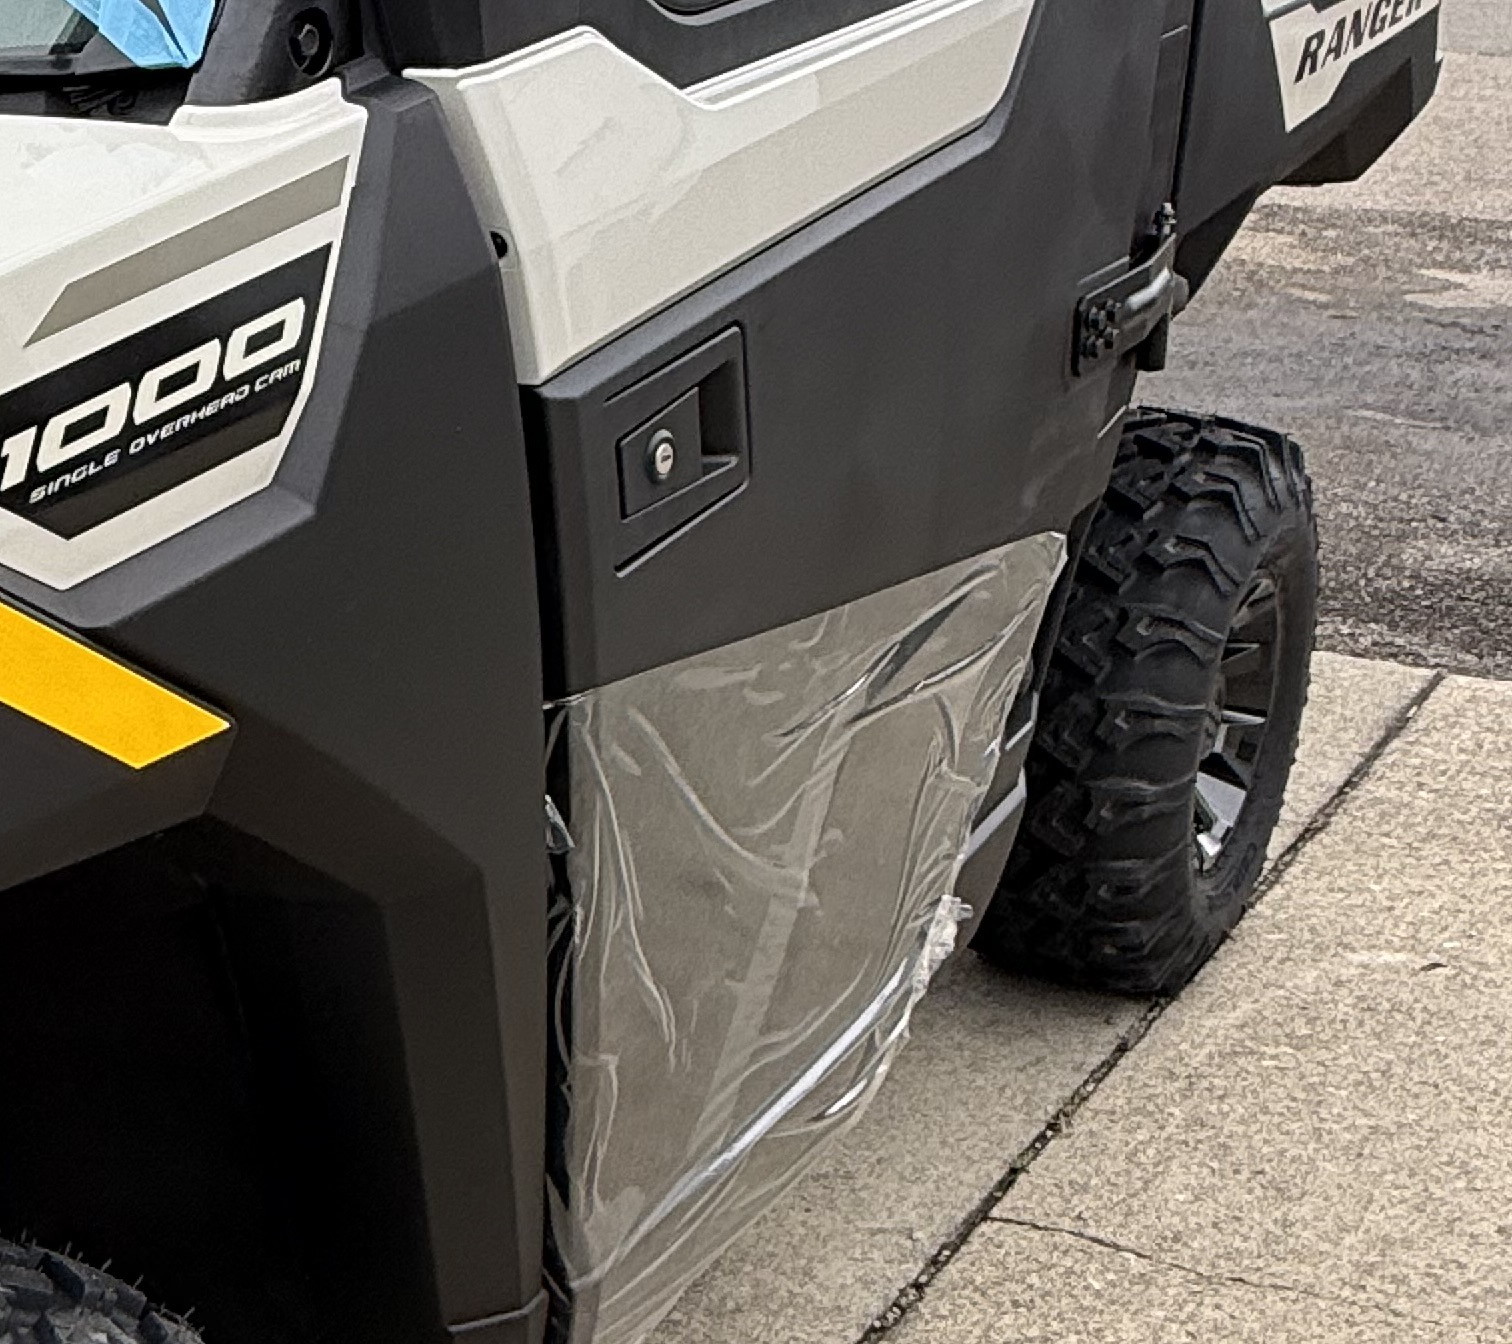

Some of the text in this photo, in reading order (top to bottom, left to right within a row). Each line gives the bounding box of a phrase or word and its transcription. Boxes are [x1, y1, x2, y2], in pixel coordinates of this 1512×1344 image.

[0, 296, 306, 493] 1000
[28, 358, 302, 504] SINGLE OVERHEAD CAM
